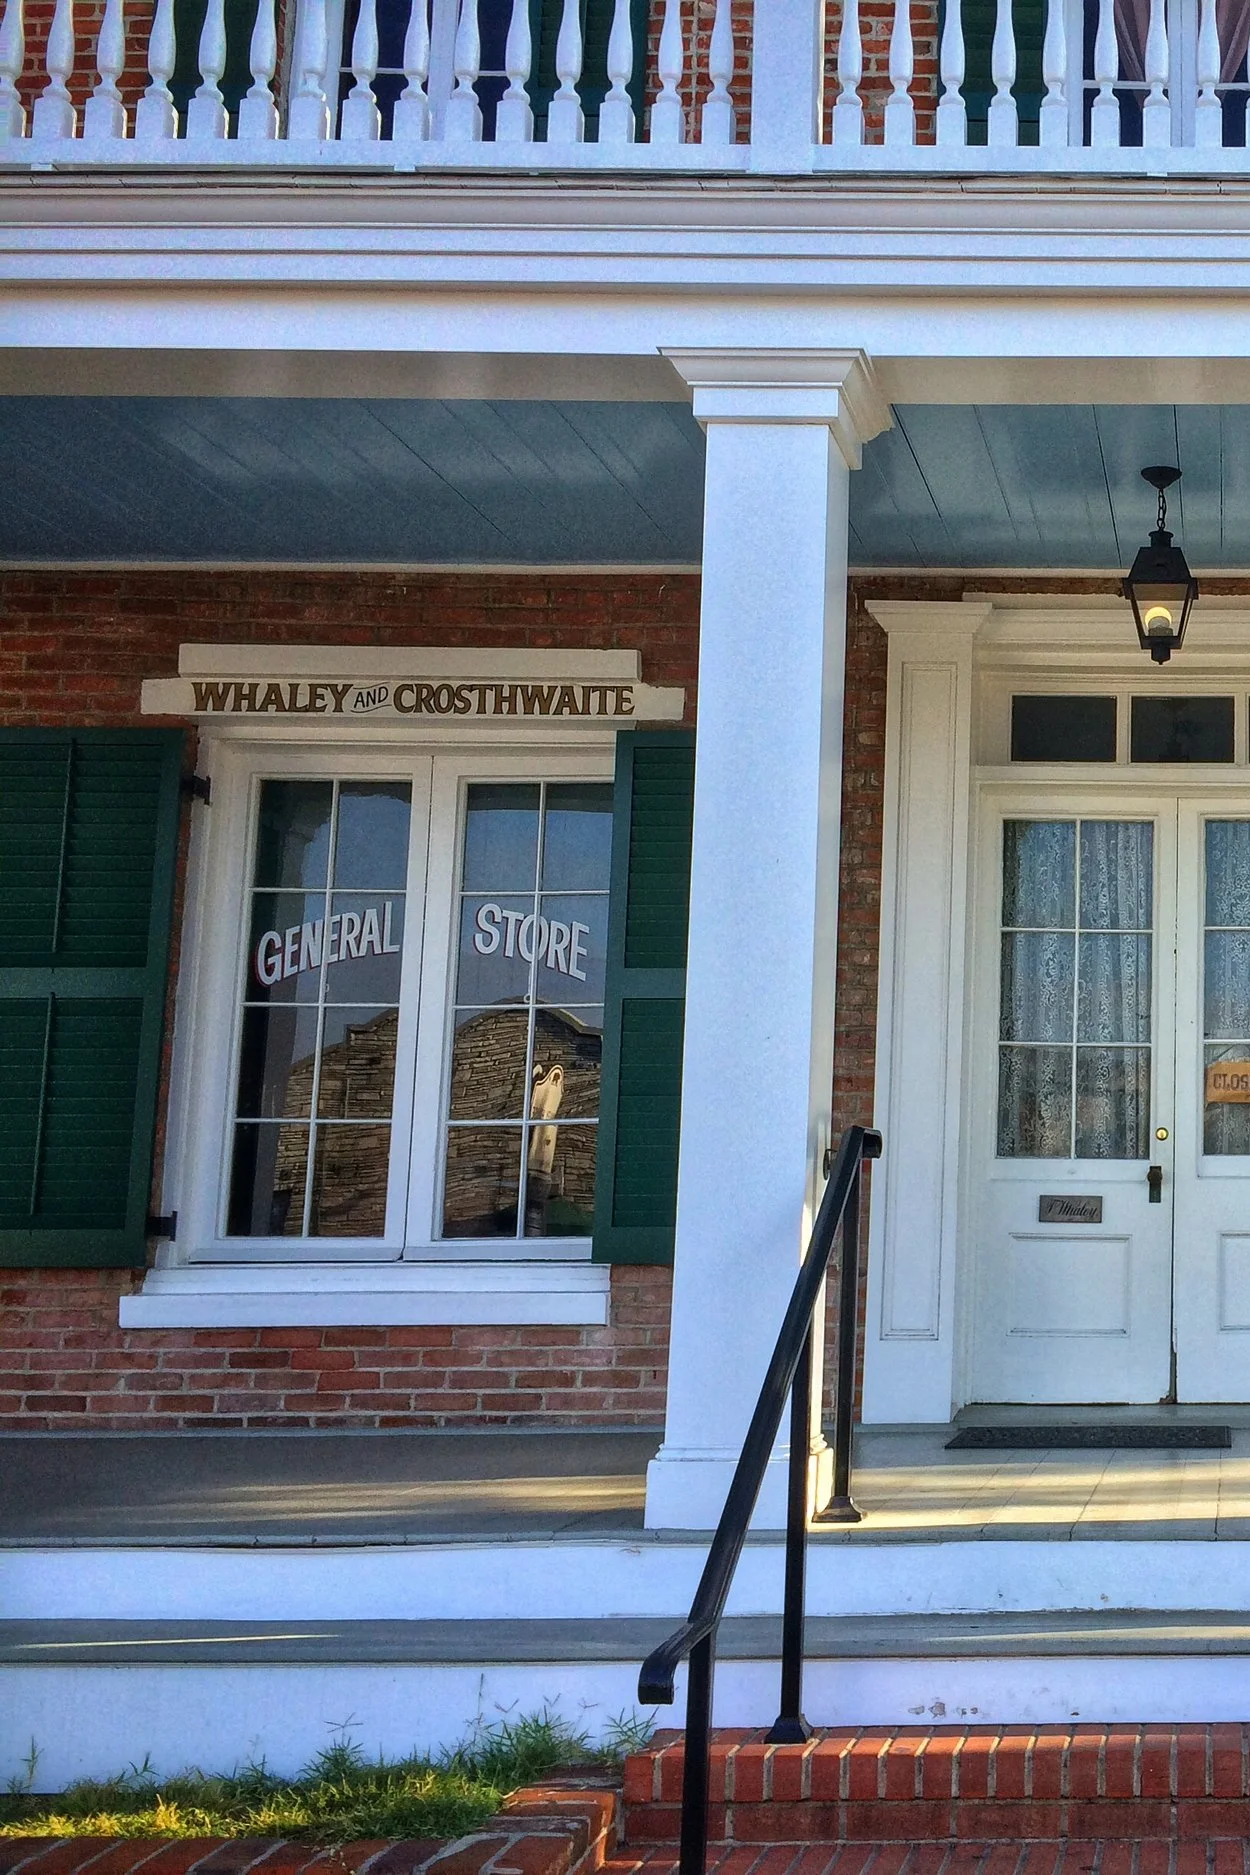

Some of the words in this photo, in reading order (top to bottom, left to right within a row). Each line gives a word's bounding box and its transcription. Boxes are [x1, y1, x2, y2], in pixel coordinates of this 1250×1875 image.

[192, 682, 354, 713] WHALEY
[353, 686, 389, 709] AND
[393, 683, 635, 716] CROSTHWAITE
[255, 901, 401, 987] GENERAL
[474, 903, 591, 982] STORE
